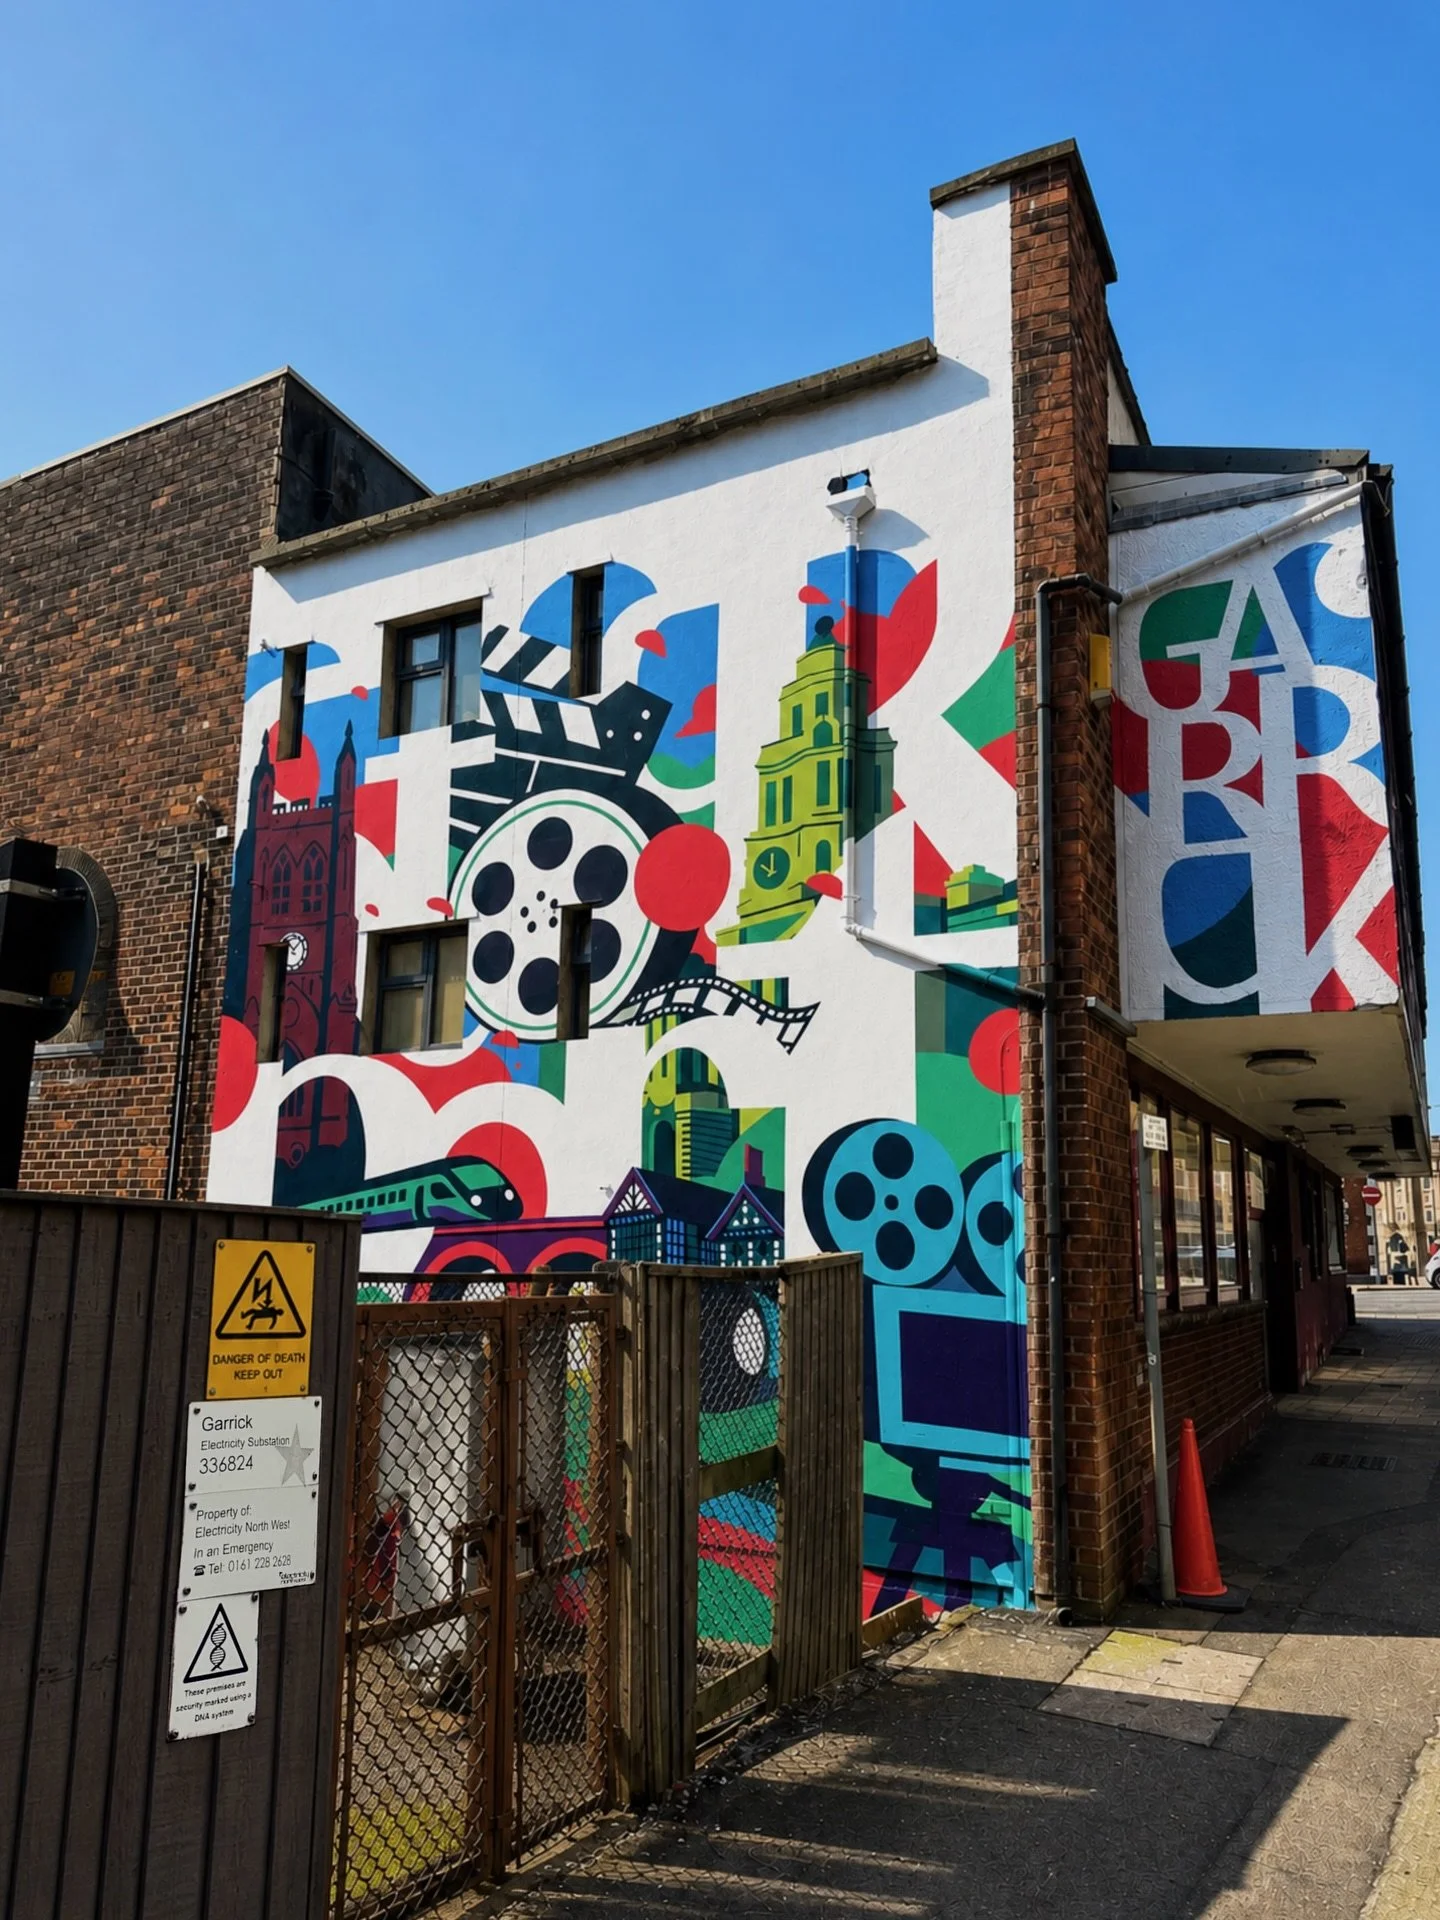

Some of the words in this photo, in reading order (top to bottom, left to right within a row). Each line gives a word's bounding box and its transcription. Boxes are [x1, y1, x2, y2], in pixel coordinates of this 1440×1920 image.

[212, 1354, 254, 1365] DANGER
[257, 1353, 271, 1363] OF
[274, 1353, 305, 1363] DEATH
[234, 1369, 260, 1380] KEEP
[263, 1368, 284, 1379] OUT
[201, 1414, 253, 1431] Garrick
[200, 1438, 245, 1450] Electricity
[247, 1436, 290, 1447] Substation
[199, 1454, 253, 1474] 336824
[196, 1507, 238, 1521] Property
[240, 1504, 252, 1516] of:
[195, 1524, 243, 1538] Electricity
[245, 1521, 269, 1532] North
[271, 1519, 290, 1530] West
[194, 1547, 204, 1559] In
[206, 1547, 219, 1557] an
[223, 1541, 274, 1555] Emergency
[228, 1559, 250, 1572] 0161
[254, 1556, 271, 1569] 228
[273, 1554, 291, 1568] 2628
[184, 1688, 204, 1697] These
[206, 1682, 235, 1695] premises
[175, 1701, 203, 1712] security
[204, 1695, 228, 1706] marked
[229, 1693, 246, 1702] using
[194, 1710, 210, 1722] DNA
[211, 1708, 234, 1720] system
